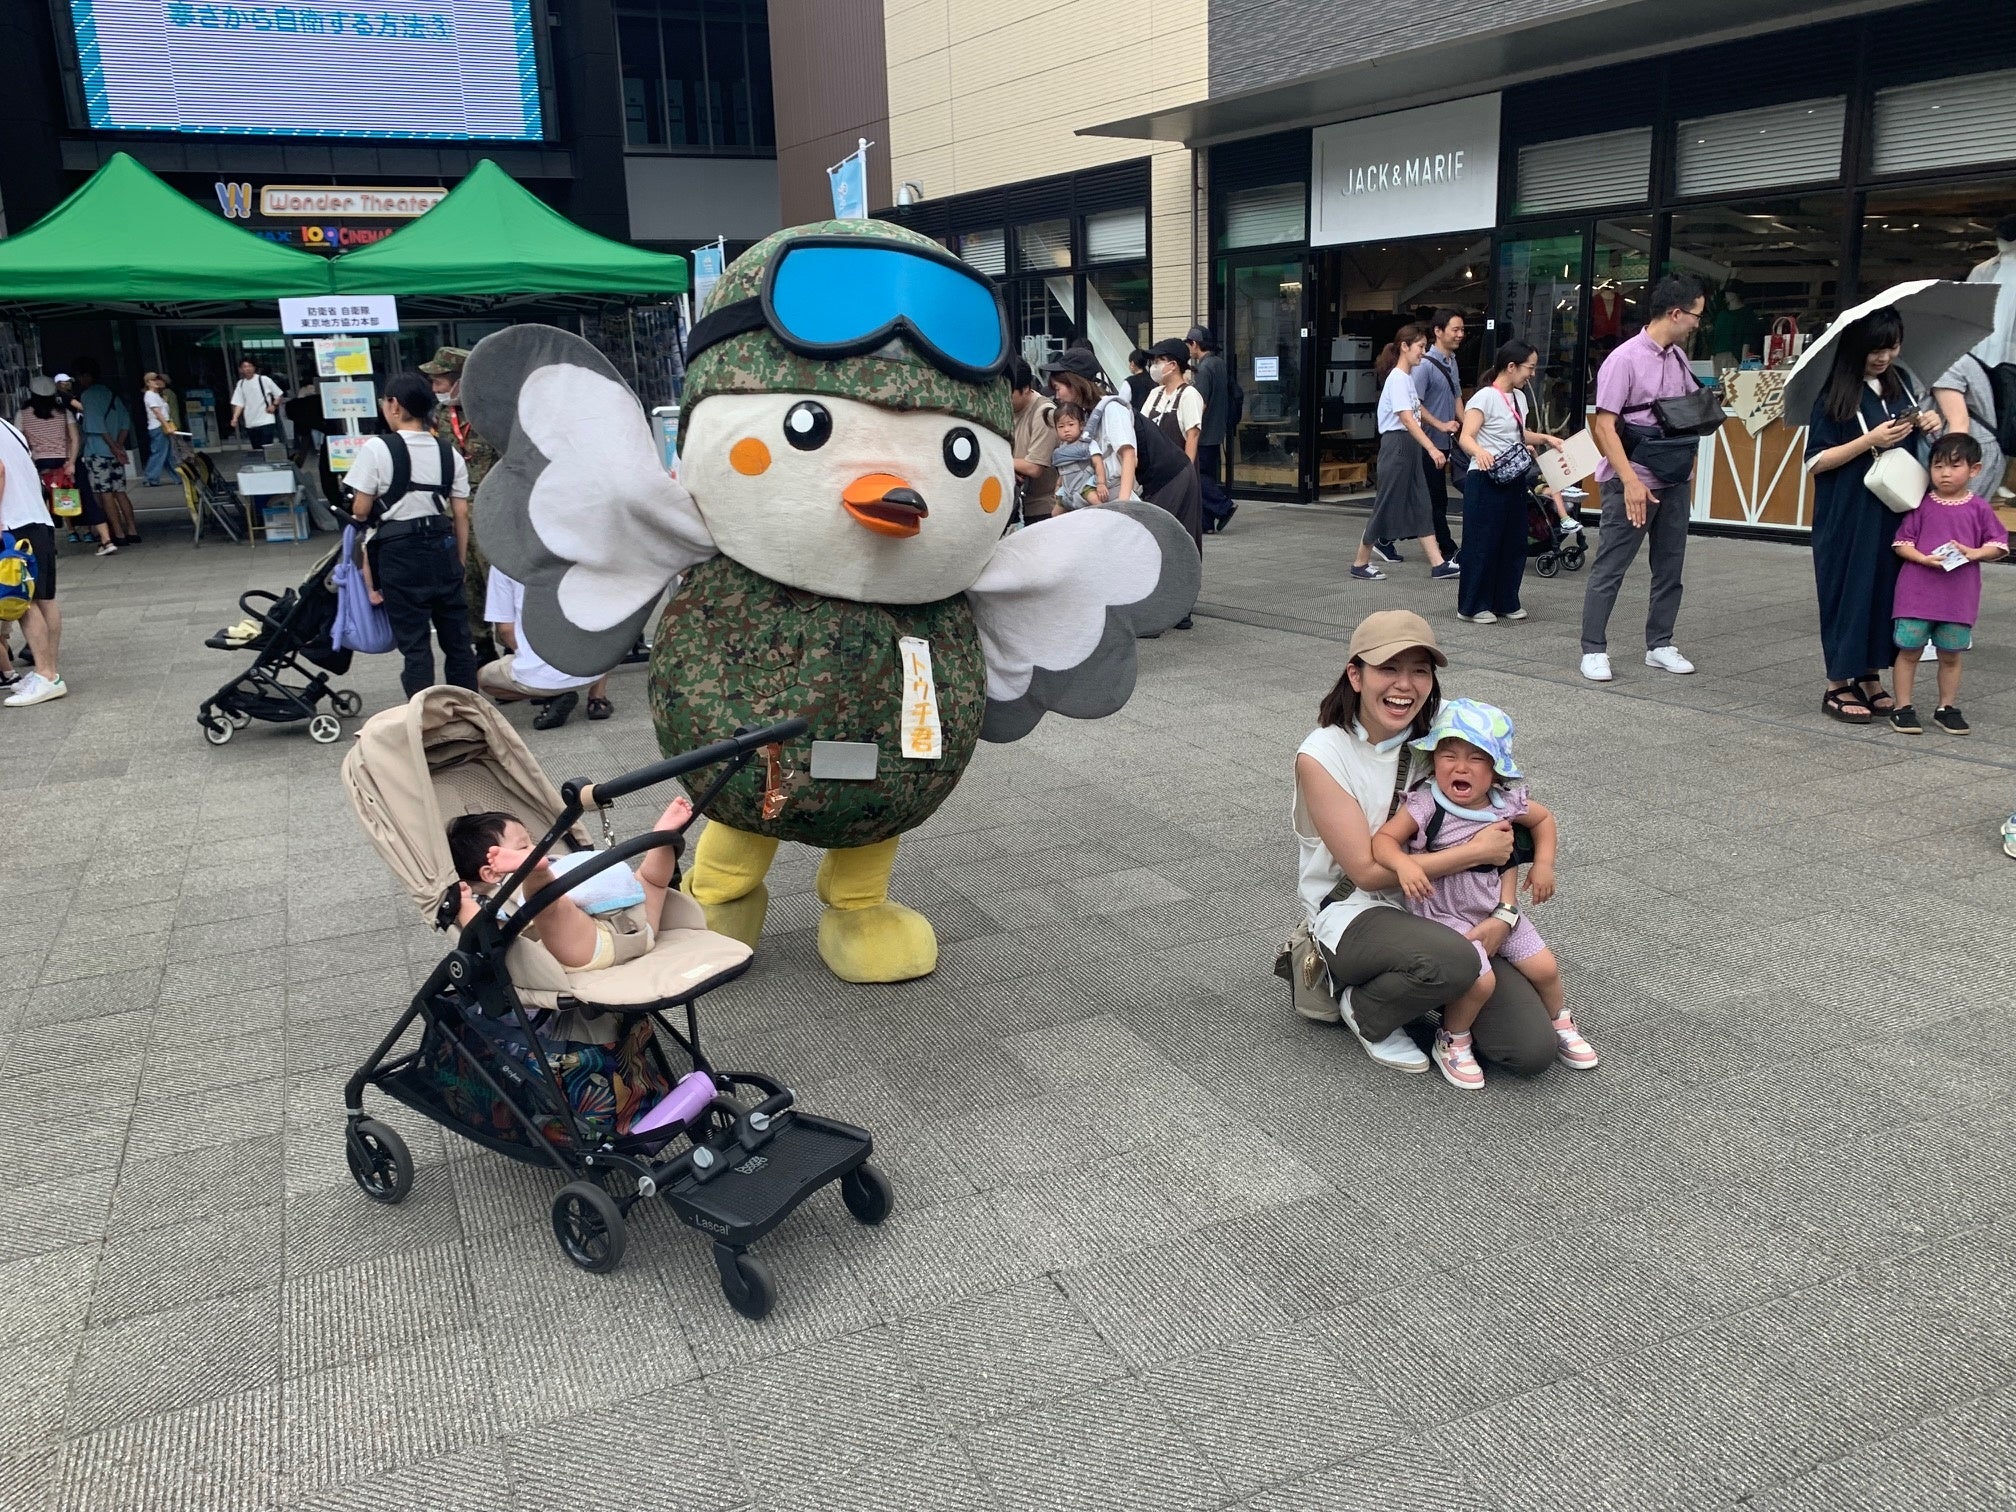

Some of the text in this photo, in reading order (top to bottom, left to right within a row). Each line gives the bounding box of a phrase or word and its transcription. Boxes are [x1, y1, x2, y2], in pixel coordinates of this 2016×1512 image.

[1341, 150, 1465, 196] JACK&MARIE
[269, 193, 353, 211] Wonder
[302, 226, 339, 247] 109
[307, 306, 370, 316] 防衛省 自衛隊
[300, 317, 380, 327] 東京地方協力本部
[695, 1213, 729, 1236] Lascal
